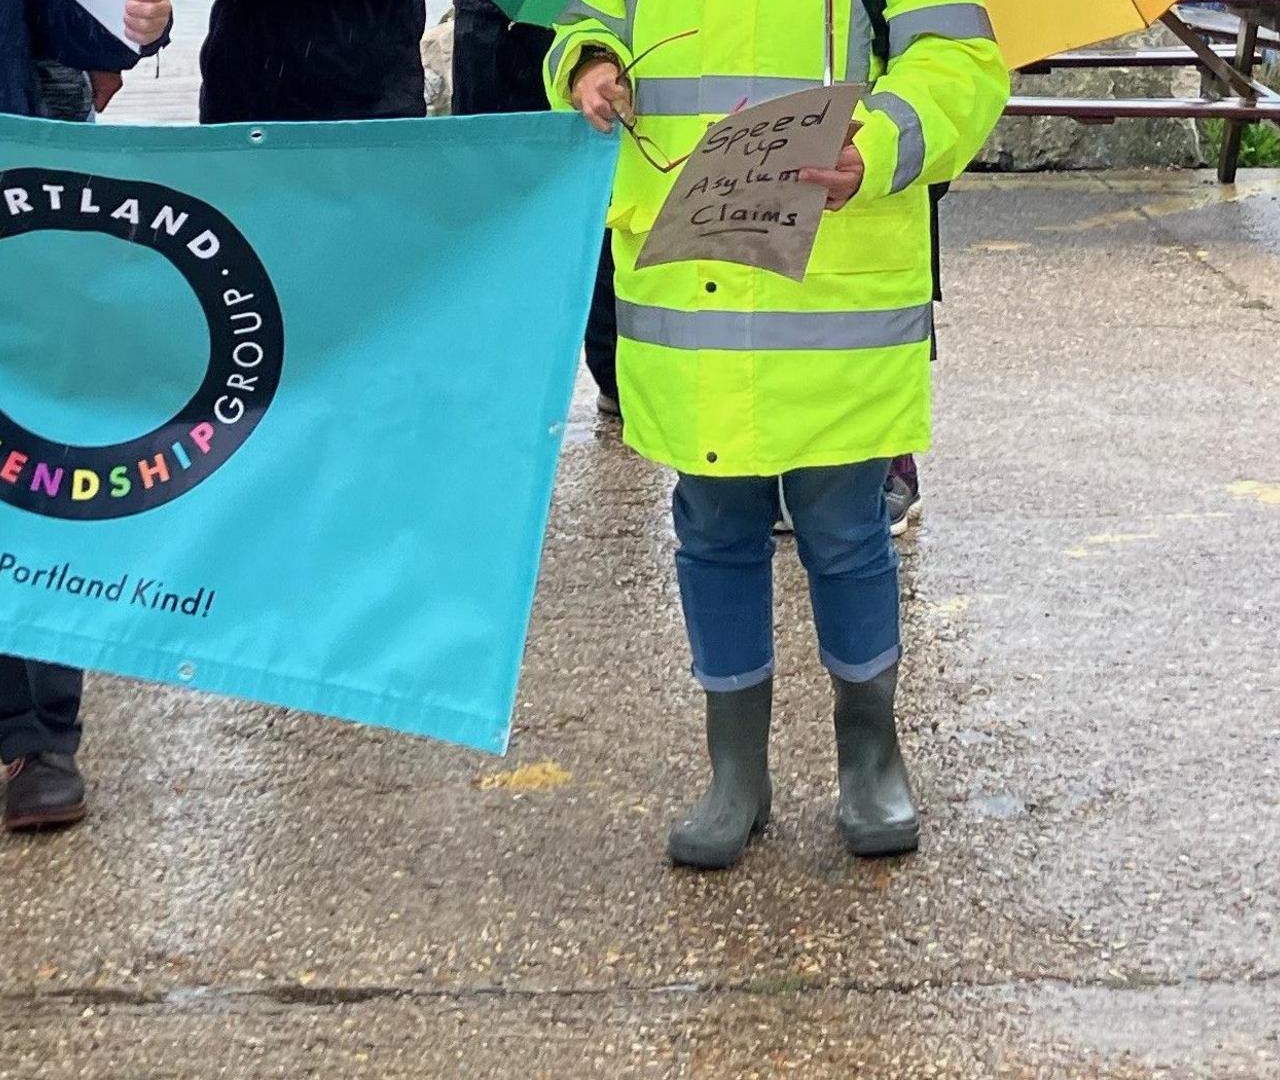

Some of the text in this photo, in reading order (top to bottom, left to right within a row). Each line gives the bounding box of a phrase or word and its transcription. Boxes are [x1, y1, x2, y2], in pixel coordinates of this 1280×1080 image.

[702, 98, 832, 154] Speed
[690, 204, 798, 227] Claims
[214, 287, 264, 424] GROUP
[130, 577, 216, 618] Kind!
